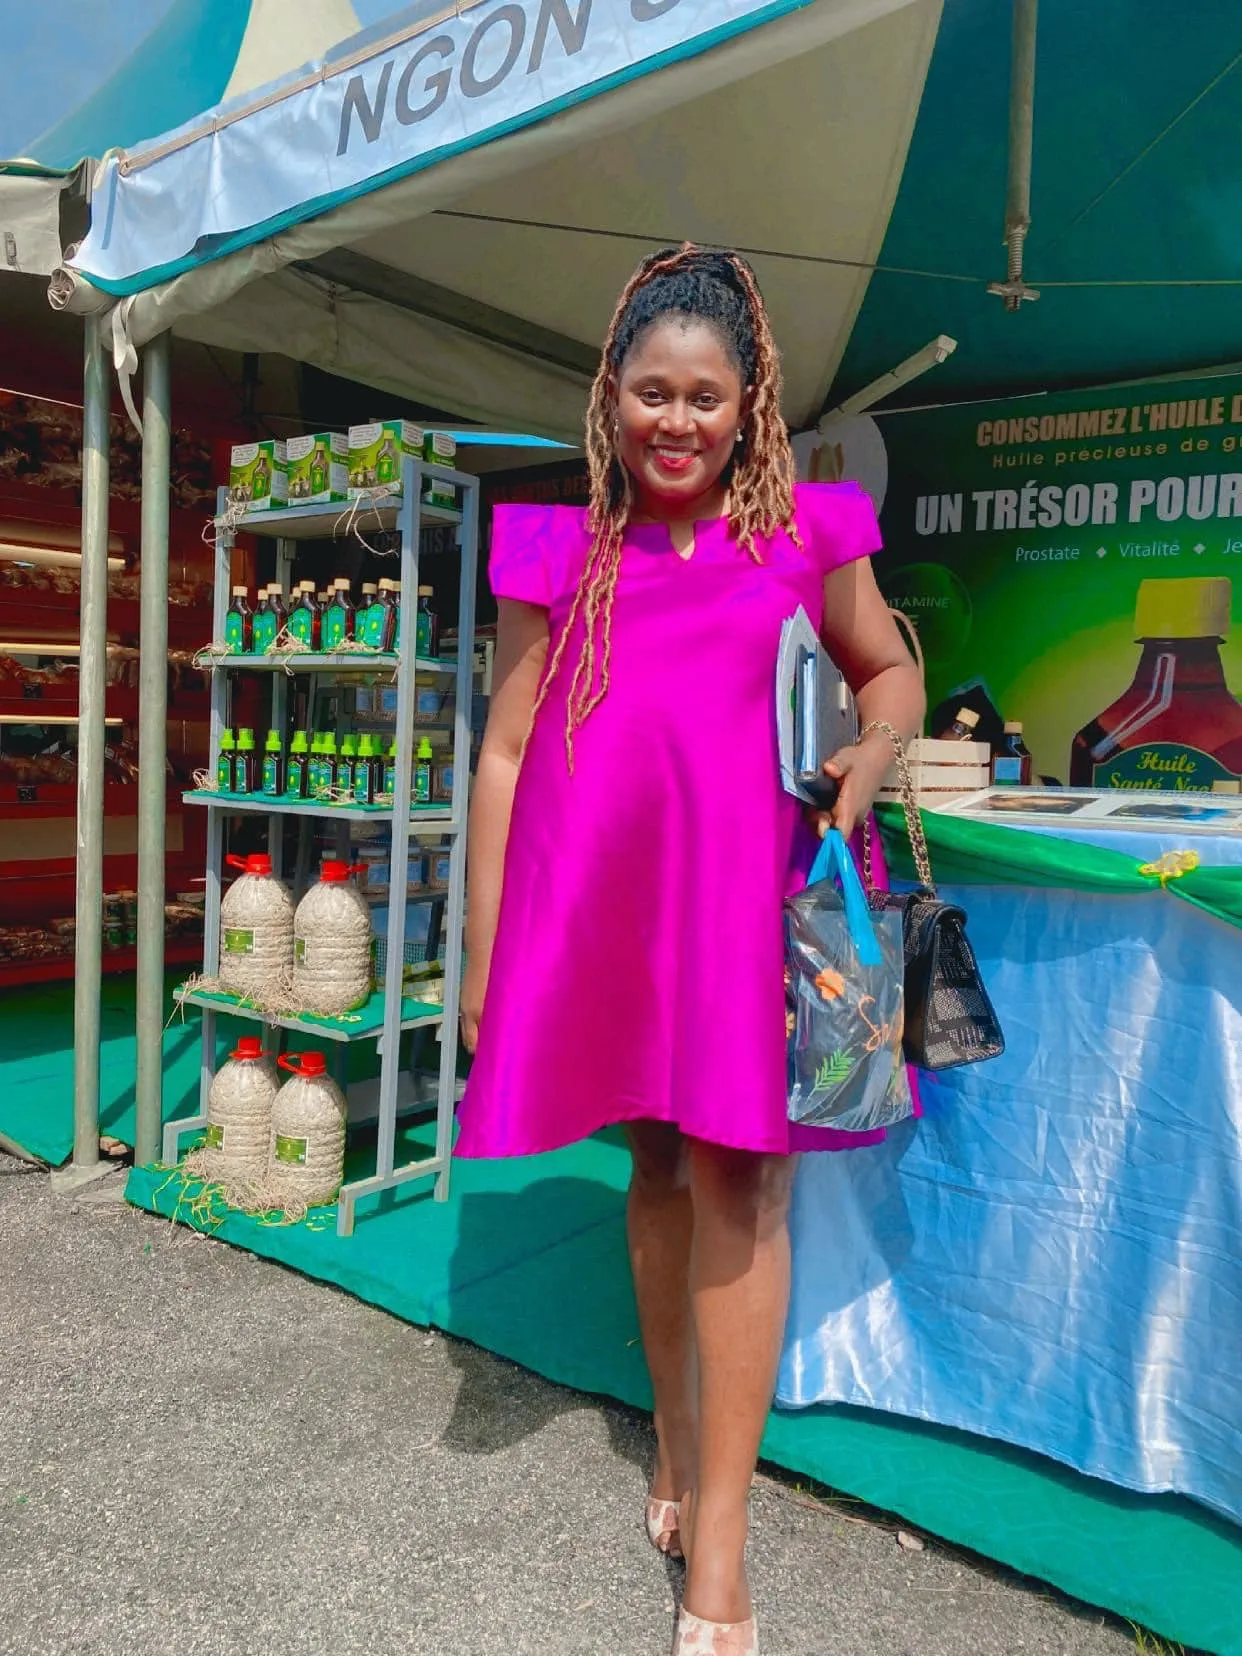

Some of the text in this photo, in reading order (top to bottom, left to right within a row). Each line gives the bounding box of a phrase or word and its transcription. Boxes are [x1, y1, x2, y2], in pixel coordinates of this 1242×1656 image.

[336, 0, 592, 156] NGON
[976, 407, 1127, 447] CONSOMMEZ
[1131, 396, 1225, 432] L'HUILE
[993, 436, 1242, 468] Huile précieuse de g
[915, 473, 1242, 536] UN TRÉSOR POUR
[1015, 546, 1080, 562] Prostate
[1119, 540, 1181, 557] Vitalité
[1137, 750, 1197, 773] Huile
